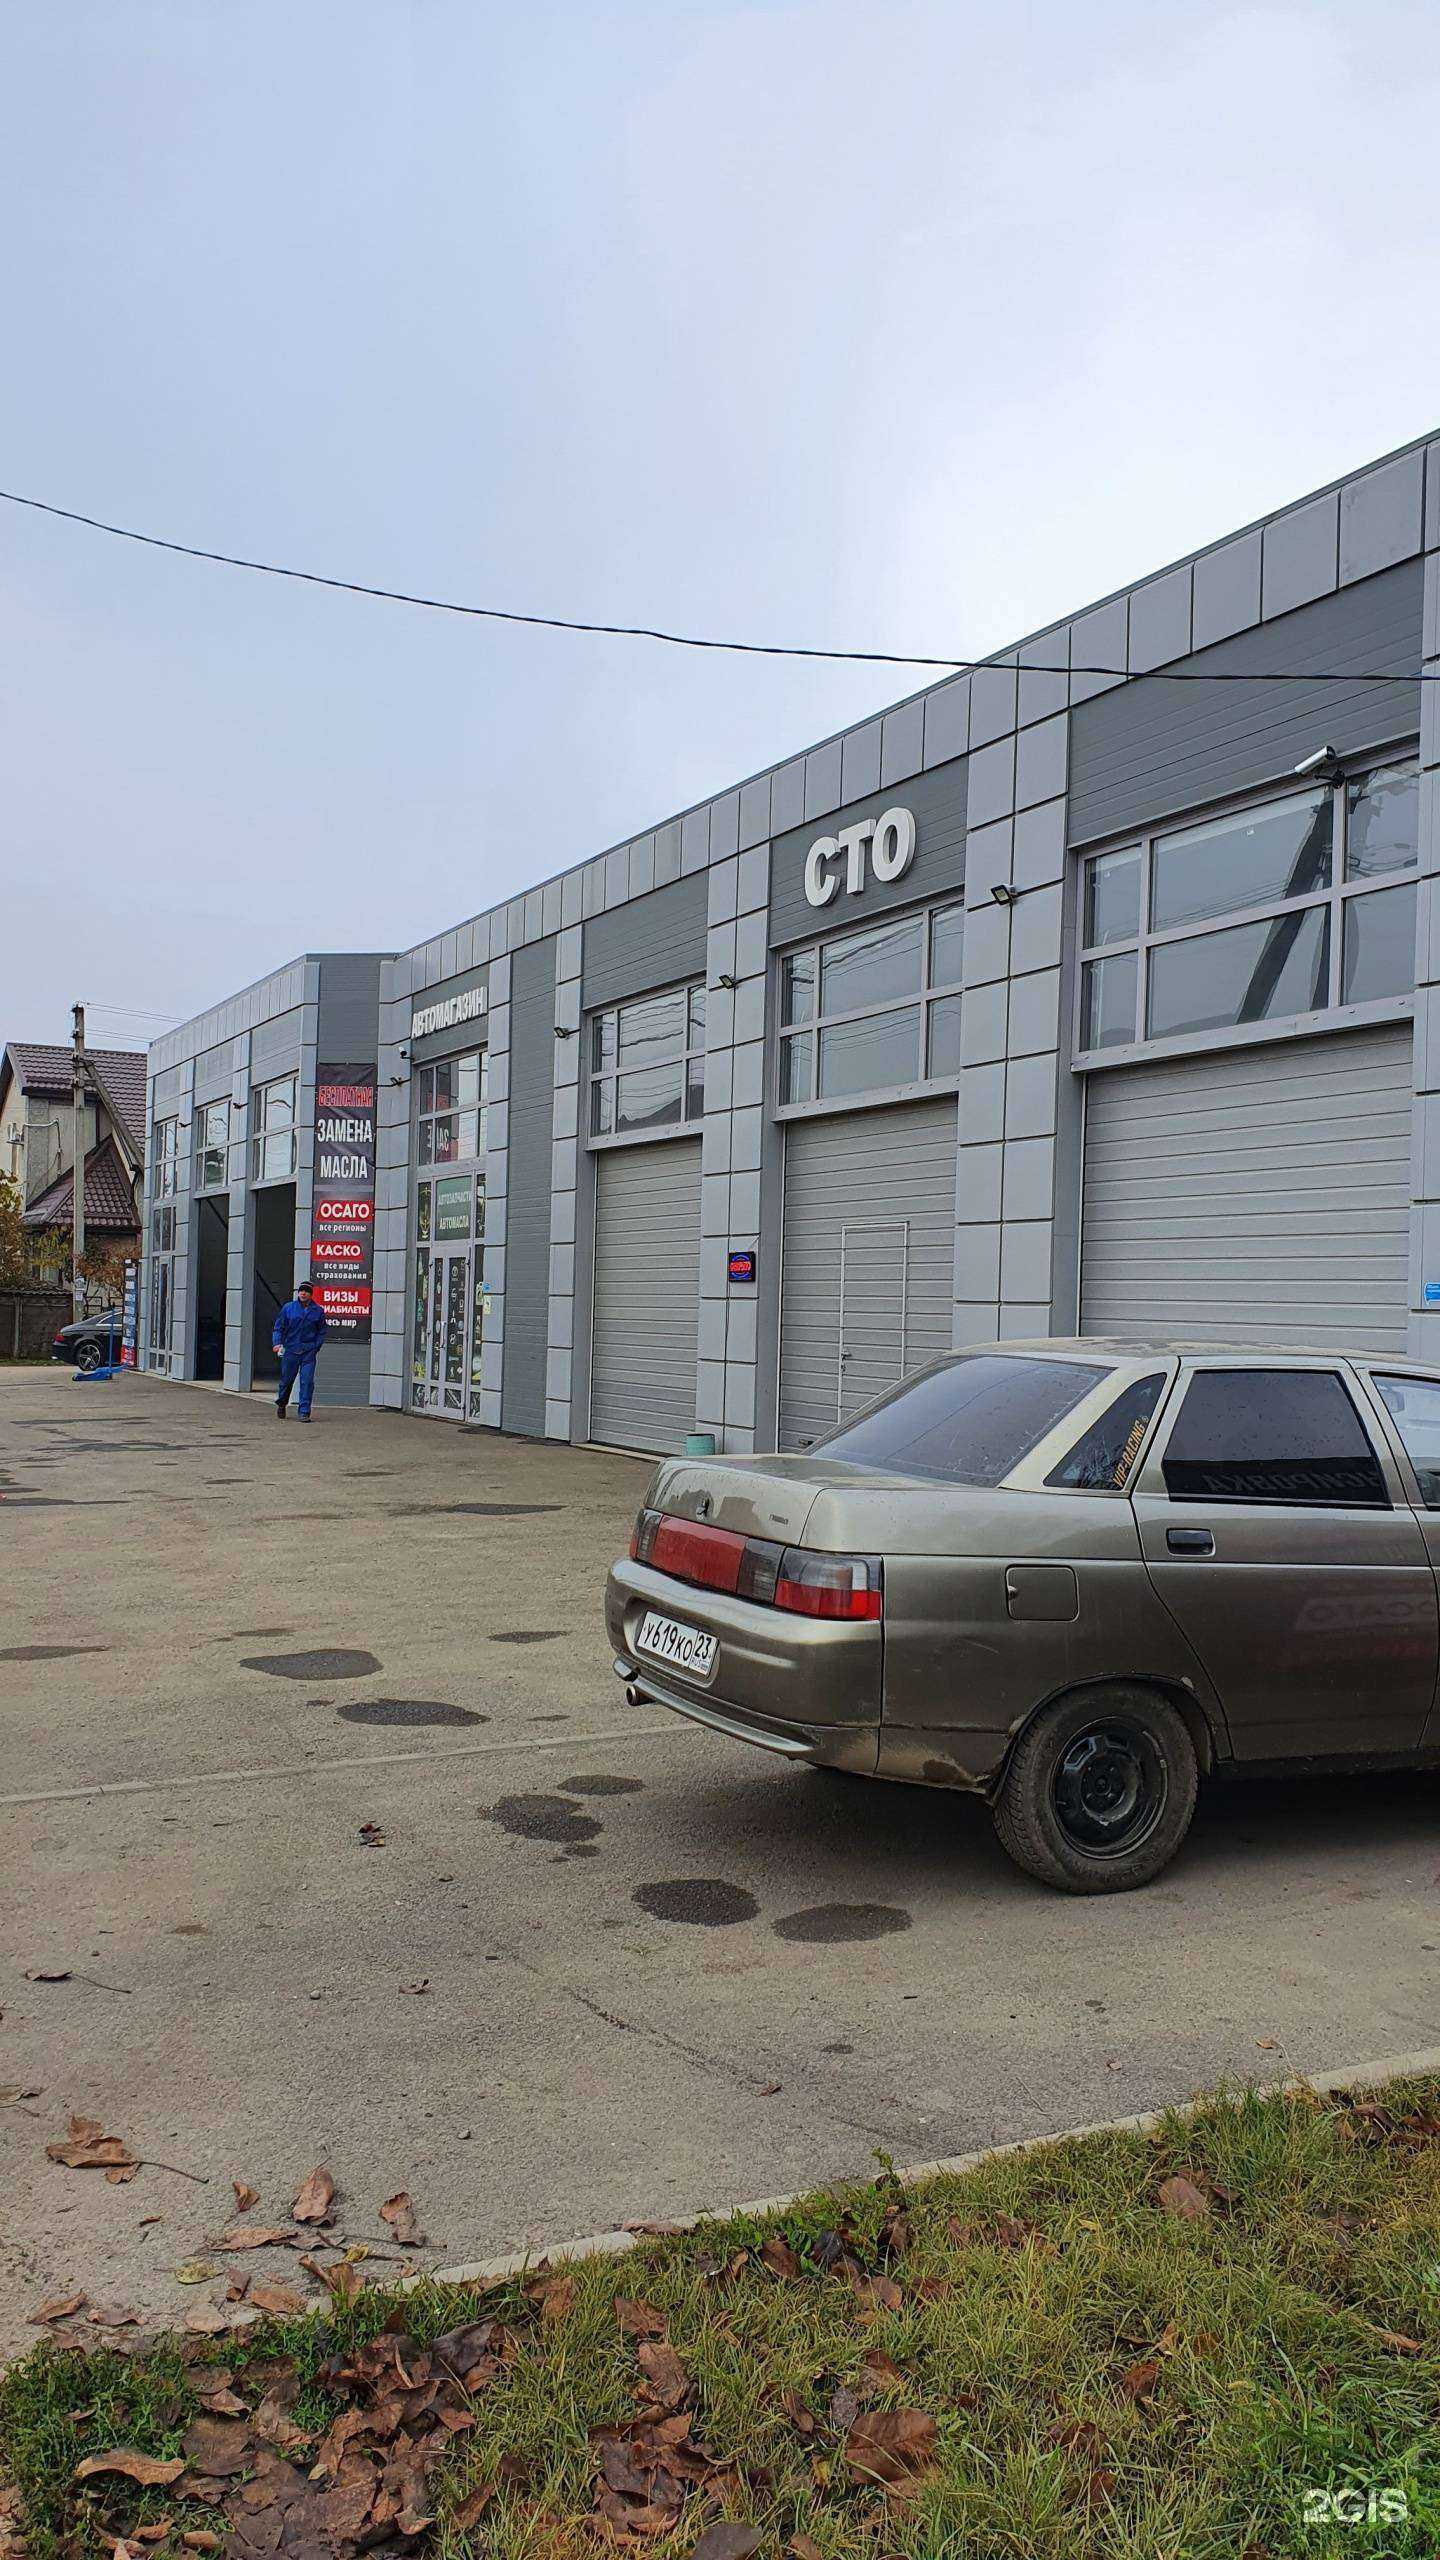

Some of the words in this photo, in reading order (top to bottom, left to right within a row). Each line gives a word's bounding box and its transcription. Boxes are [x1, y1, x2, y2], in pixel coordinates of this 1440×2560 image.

[804, 806, 917, 908] СТО
[411, 986, 488, 1039] АВТОМАГАЗИН
[318, 1085, 374, 1108] БЕСПЛАТНАЯ
[317, 1119, 373, 1142] ЗАМЕНА
[320, 1155, 368, 1179] МАСЛА
[320, 1203, 370, 1219] ОСАГО
[333, 1224, 367, 1234] регионы
[316, 1244, 361, 1257] КАСКО
[338, 1263, 360, 1271] виды
[316, 1272, 367, 1280] страхования
[323, 1290, 359, 1303] ВИЗЫ
[321, 1304, 370, 1314] ИАБИЛЕТЫ
[341, 1319, 357, 1329] мир
[1112, 1419, 1145, 1488] VIP-RACING
